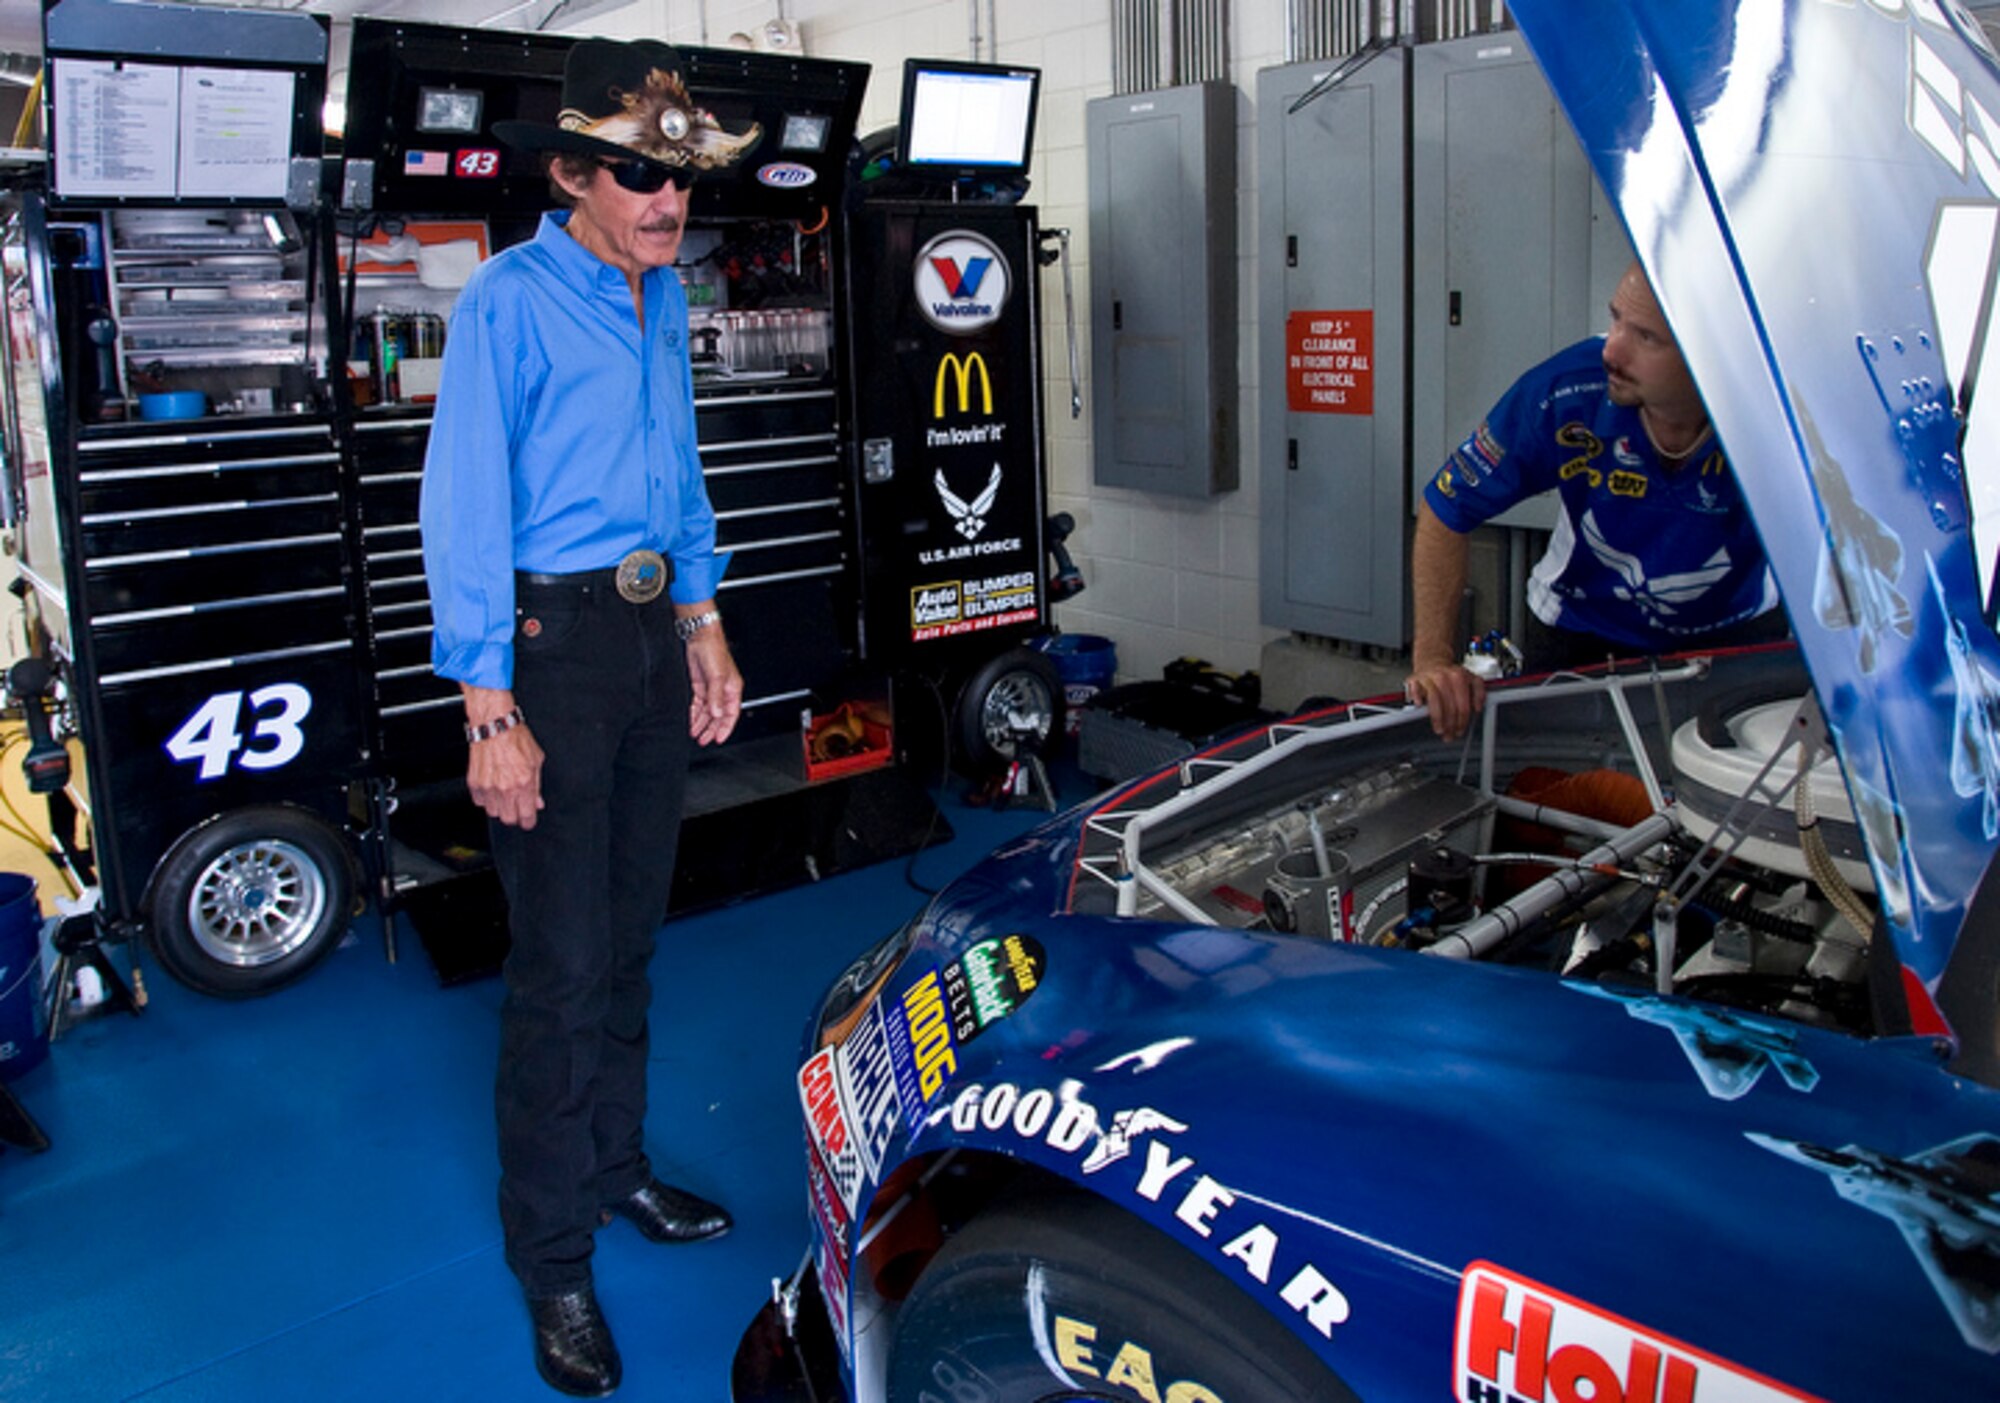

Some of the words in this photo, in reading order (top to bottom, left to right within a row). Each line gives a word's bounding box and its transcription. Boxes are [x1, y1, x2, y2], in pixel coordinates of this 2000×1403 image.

[460, 151, 498, 174] 43
[932, 302, 992, 317] Valvoline
[1310, 321, 1334, 334] KEEP
[1302, 338, 1356, 353] CLEARANCE
[1291, 355, 1301, 368] IN
[1303, 355, 1334, 369] FRONT
[1335, 355, 1350, 369] OF
[1350, 355, 1369, 370] ALL
[1302, 372, 1356, 387] ELECTRICAL
[1311, 389, 1347, 404] PANELS
[919, 548, 947, 565] U.S.
[948, 545, 973, 560] AIR
[974, 538, 1021, 557] FORCE
[963, 571, 1035, 595] BUMPER
[919, 589, 957, 607] Auto
[963, 592, 1035, 617] BUMPER
[165, 682, 312, 779] 43
[943, 962, 976, 1041] BELTS
[902, 969, 958, 1104] MOOG
[802, 1053, 847, 1157] COMP
